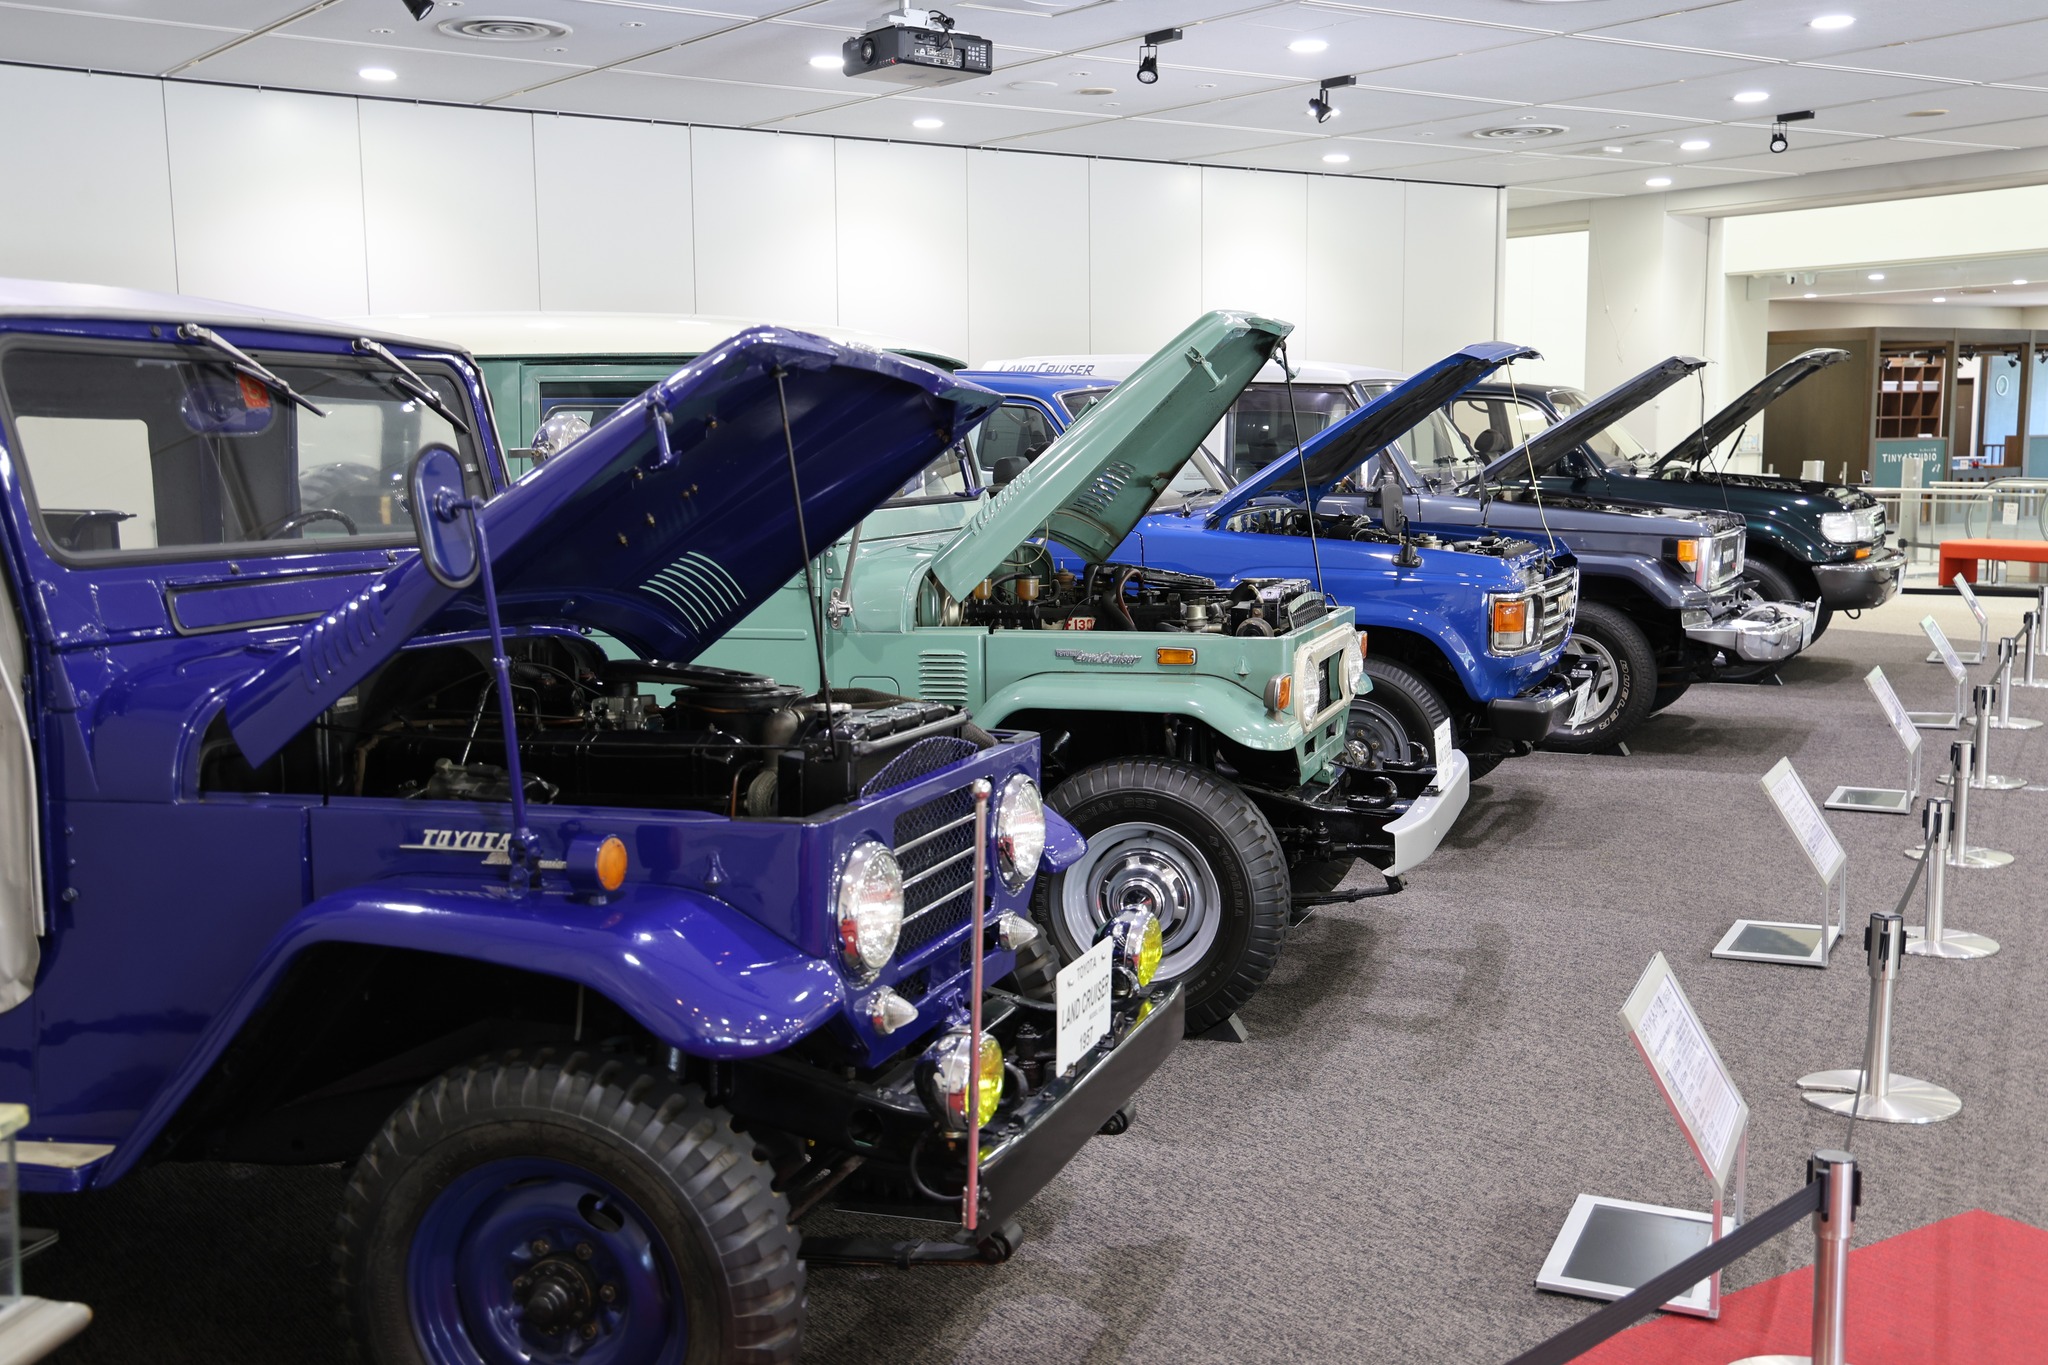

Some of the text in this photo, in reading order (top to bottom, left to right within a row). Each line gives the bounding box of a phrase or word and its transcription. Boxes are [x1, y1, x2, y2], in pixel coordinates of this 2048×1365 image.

[1038, 363, 1095, 376] CRUISER
[422, 829, 512, 851] TOYOTA
[1077, 956, 1098, 981] TOYOTA
[1061, 998, 1080, 1031] LAND
[1081, 974, 1109, 1014] CRUISER
[1079, 1026, 1094, 1052] 1957
